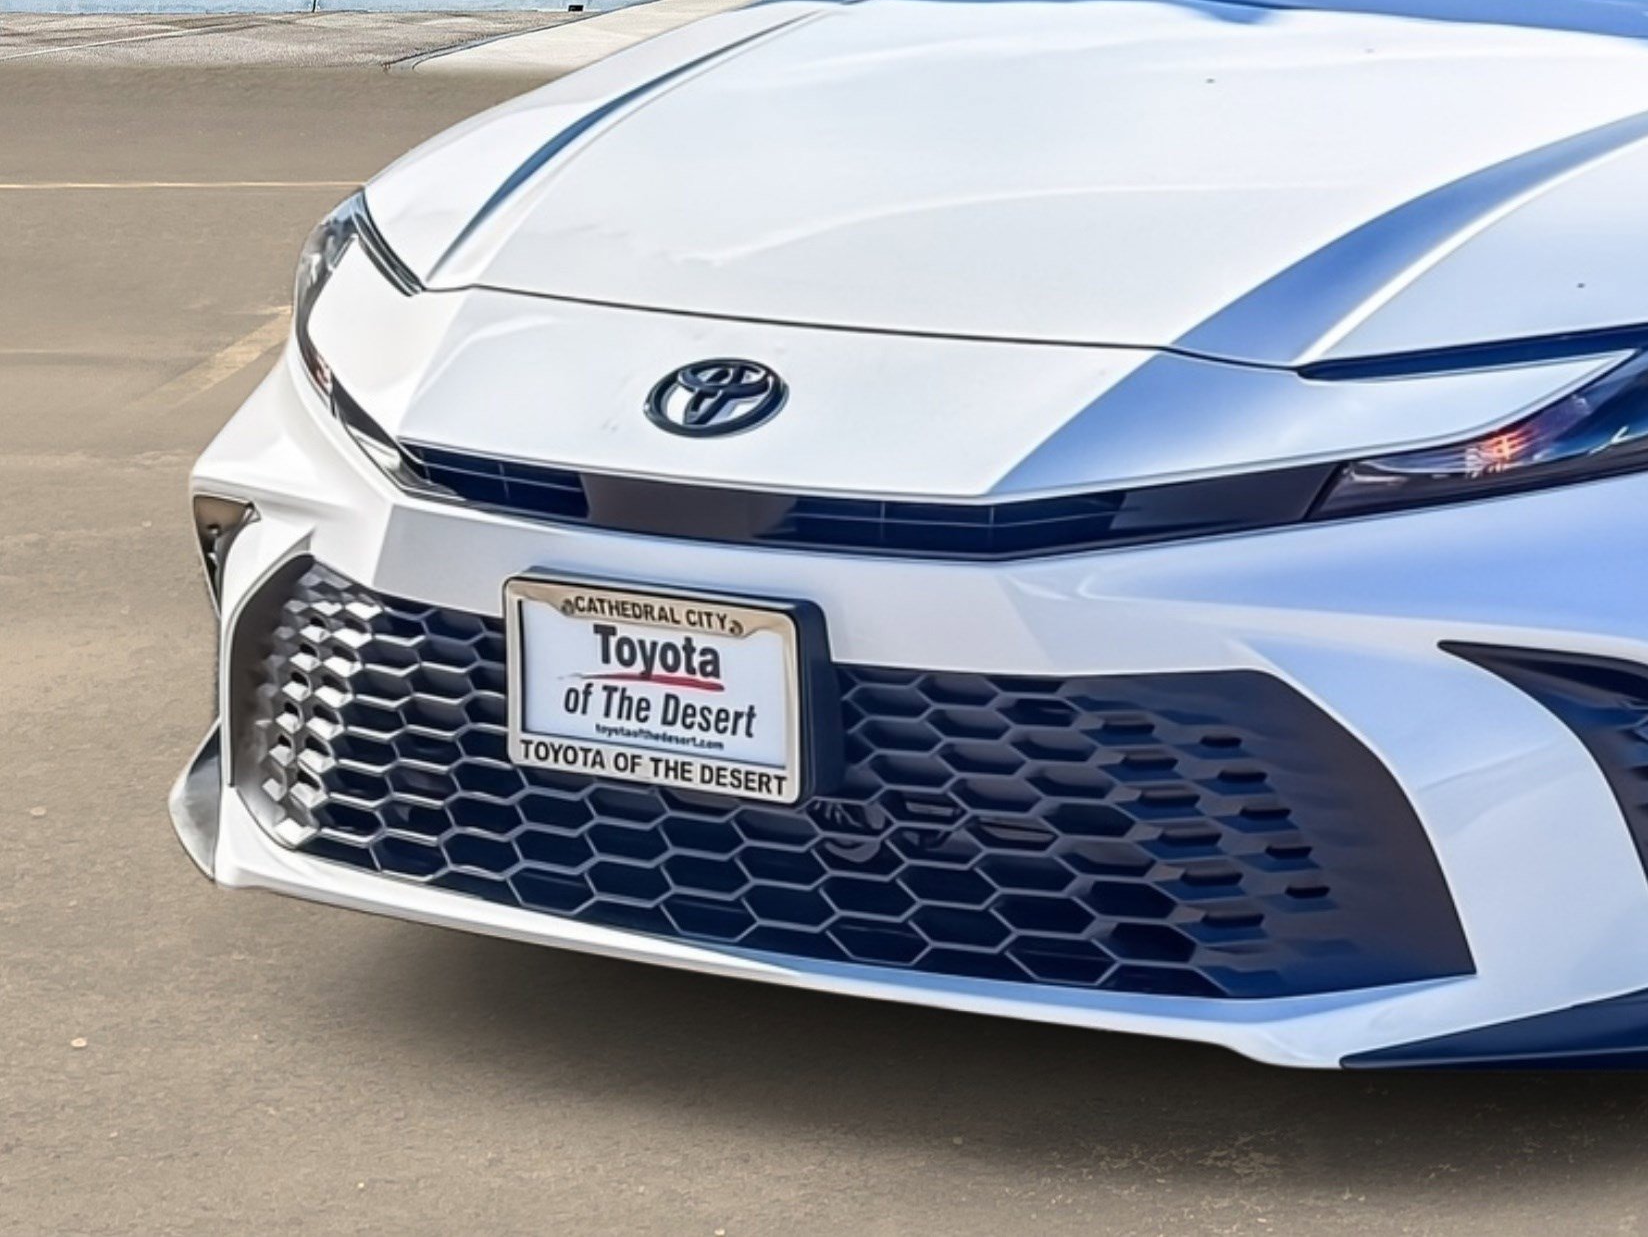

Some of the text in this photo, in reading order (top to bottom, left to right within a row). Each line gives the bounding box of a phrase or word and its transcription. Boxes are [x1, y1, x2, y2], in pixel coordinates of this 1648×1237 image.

[574, 595, 727, 630] CATHEDRAL CITY
[593, 624, 720, 679] Toyota
[564, 682, 757, 738] of The Desert
[595, 723, 724, 751] toyotaofthedesert.com
[520, 739, 788, 796] TOYOTA OF THE DESERT
